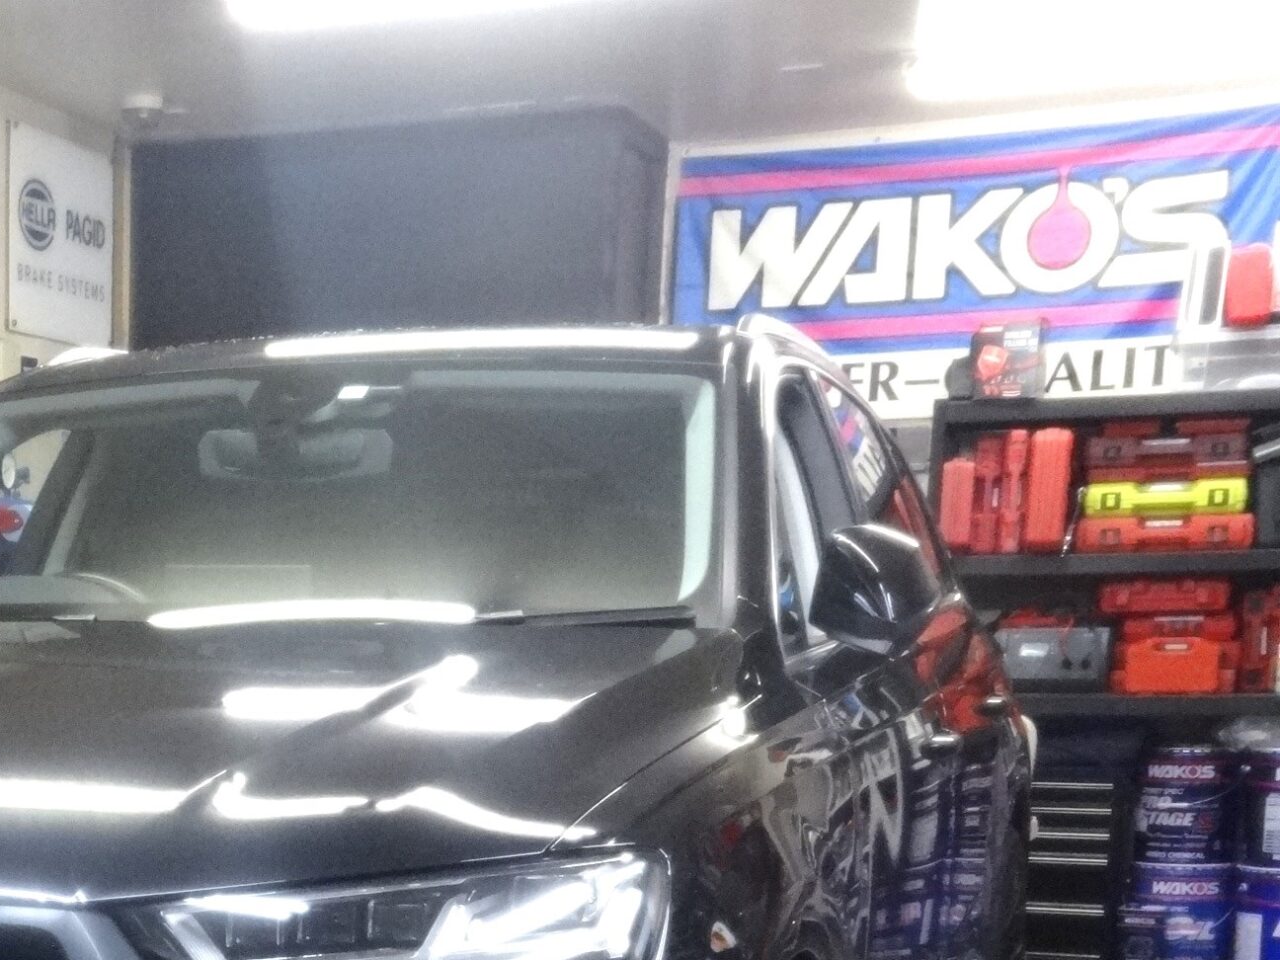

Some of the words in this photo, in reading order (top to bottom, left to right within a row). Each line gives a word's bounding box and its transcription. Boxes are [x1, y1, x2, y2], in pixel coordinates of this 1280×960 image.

[65, 209, 106, 249] PAGID
[16, 262, 52, 289] BRAKE
[57, 274, 105, 302] SYSTEMS
